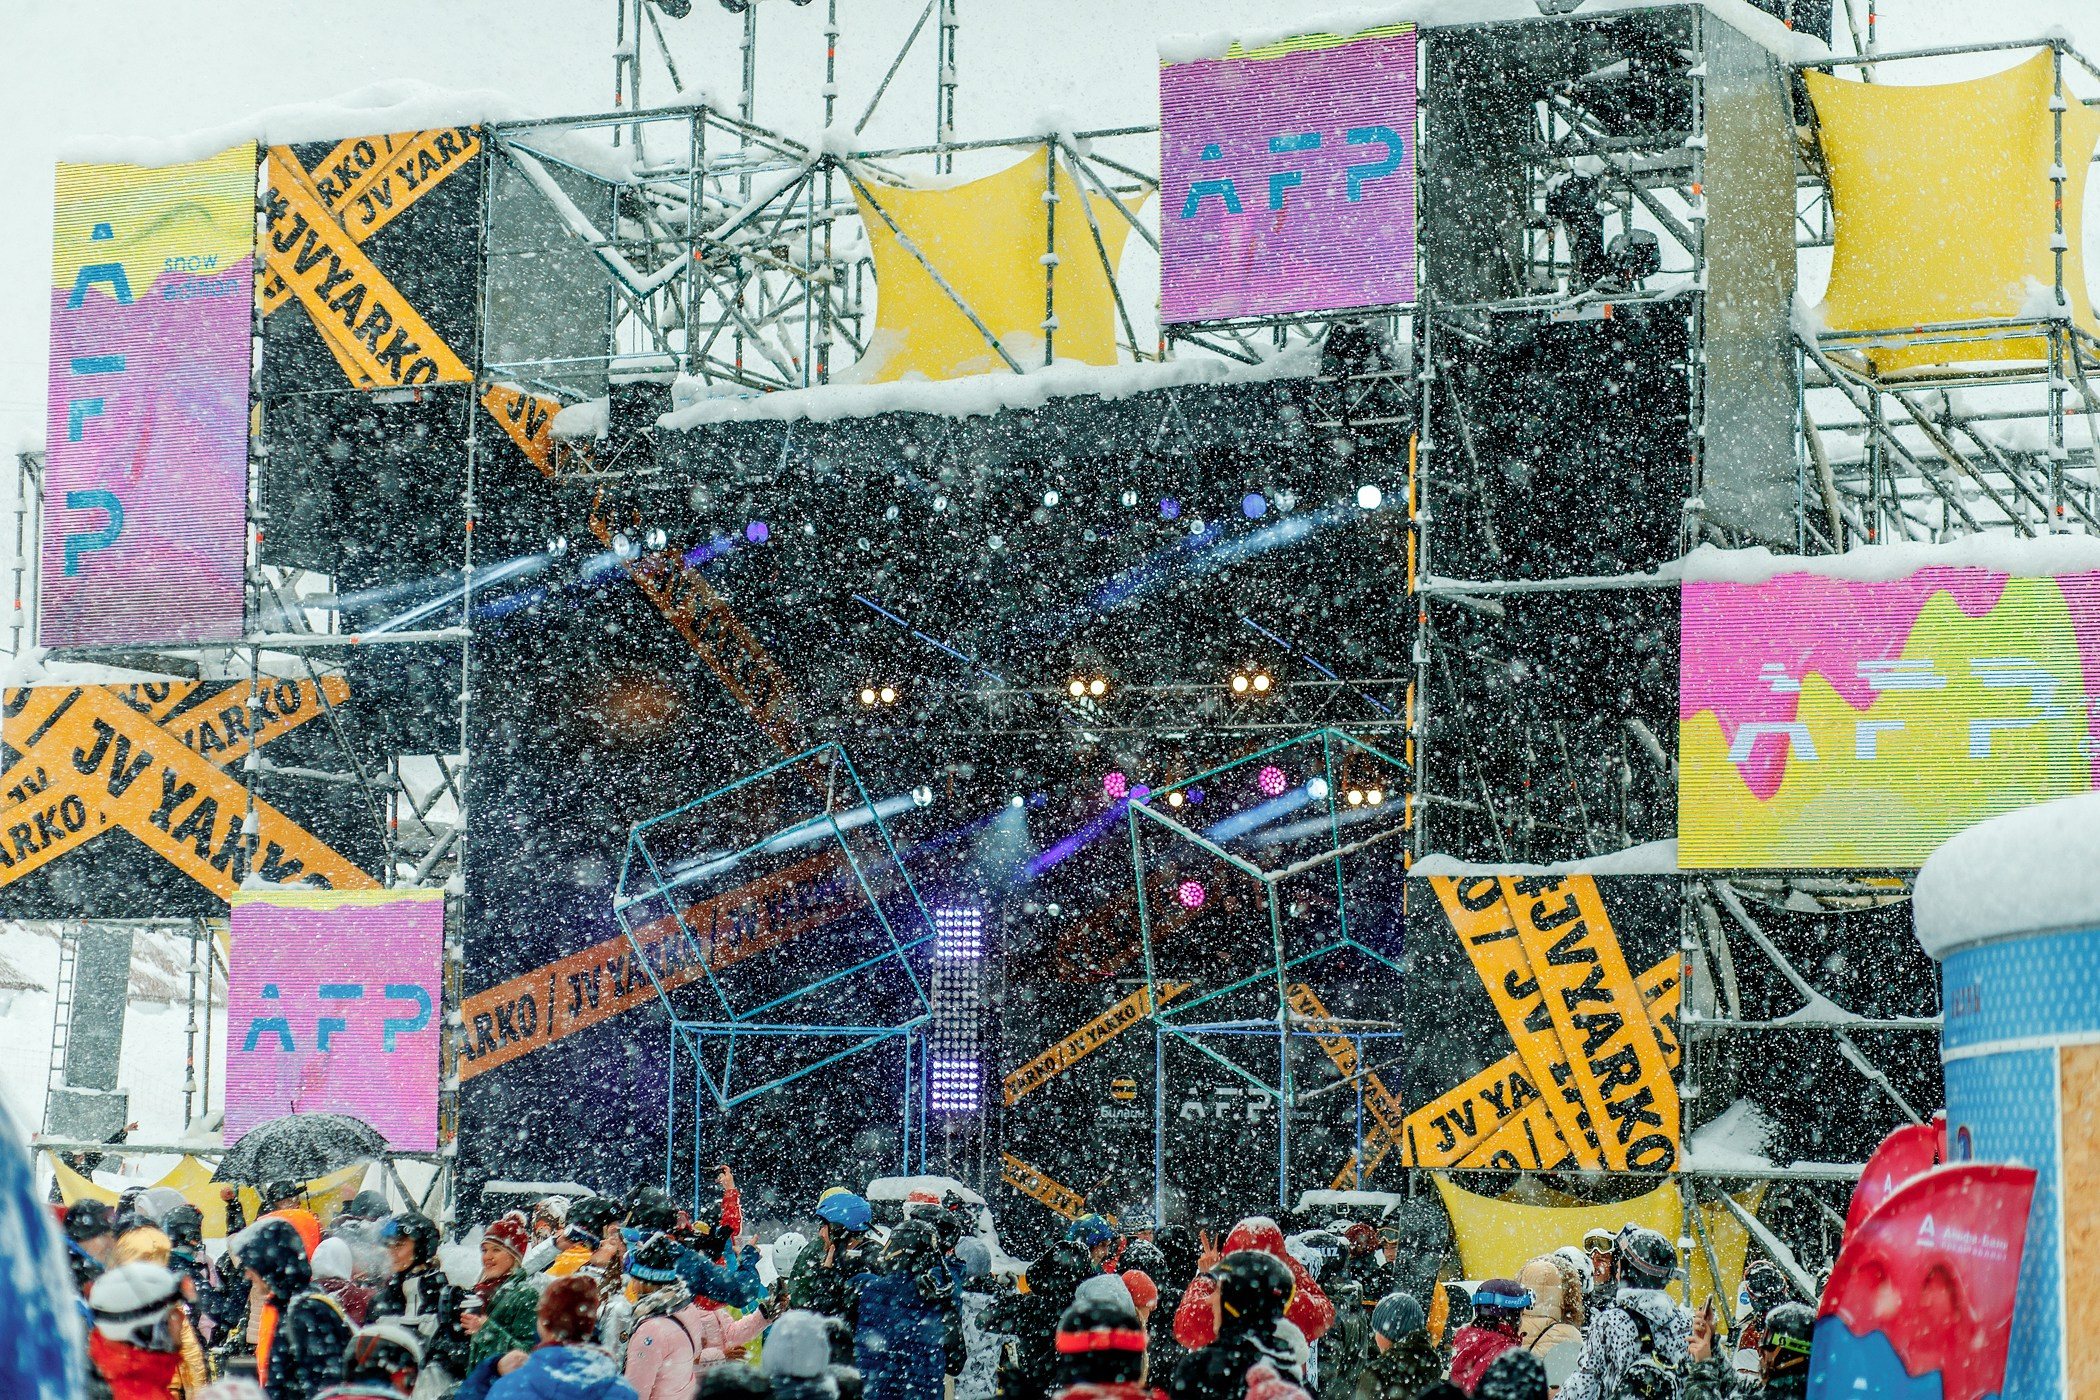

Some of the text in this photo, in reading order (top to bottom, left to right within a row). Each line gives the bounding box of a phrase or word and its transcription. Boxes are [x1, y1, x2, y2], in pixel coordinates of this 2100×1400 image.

[1180, 126, 1405, 219] AFP
[360, 177, 393, 225] JV
[163, 253, 218, 273] snow
[163, 275, 240, 301] edition
[1727, 657, 2068, 762] AFP
[72, 716, 154, 799] JV
[242, 984, 433, 1053] AFP
[567, 963, 602, 1019] JV
[1179, 1087, 1272, 1119] AFP
[1429, 1098, 1481, 1154] JV
